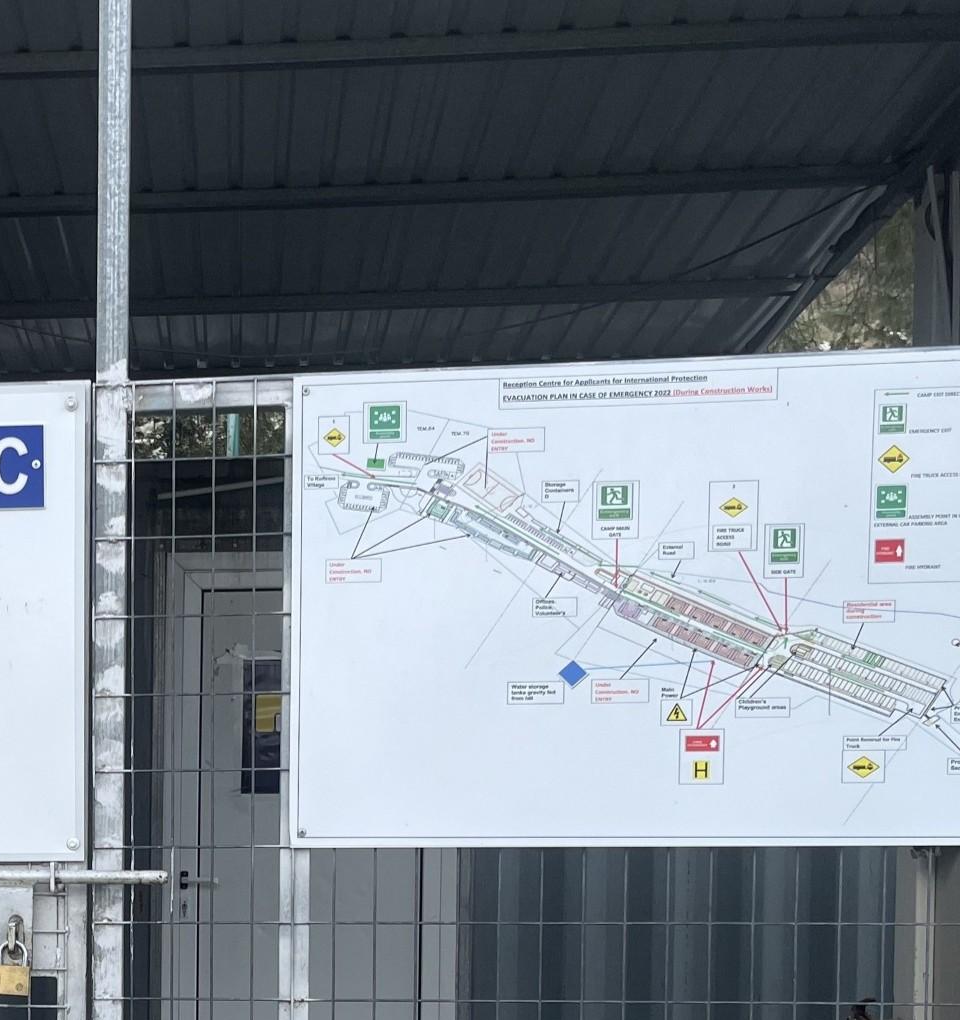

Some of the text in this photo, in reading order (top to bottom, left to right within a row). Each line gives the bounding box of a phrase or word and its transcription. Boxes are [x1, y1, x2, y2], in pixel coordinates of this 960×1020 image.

[503, 381, 537, 389] Reception
[575, 379, 611, 387] Applicants
[624, 376, 669, 384] International
[503, 393, 548, 401] EVACUATION
[609, 390, 652, 399] EMERGENCY
[654, 389, 671, 397] 2022
[672, 388, 699, 397] (During
[701, 387, 745, 395] Construction
[747, 386, 772, 394] Works)
[694, 761, 708, 779] H
